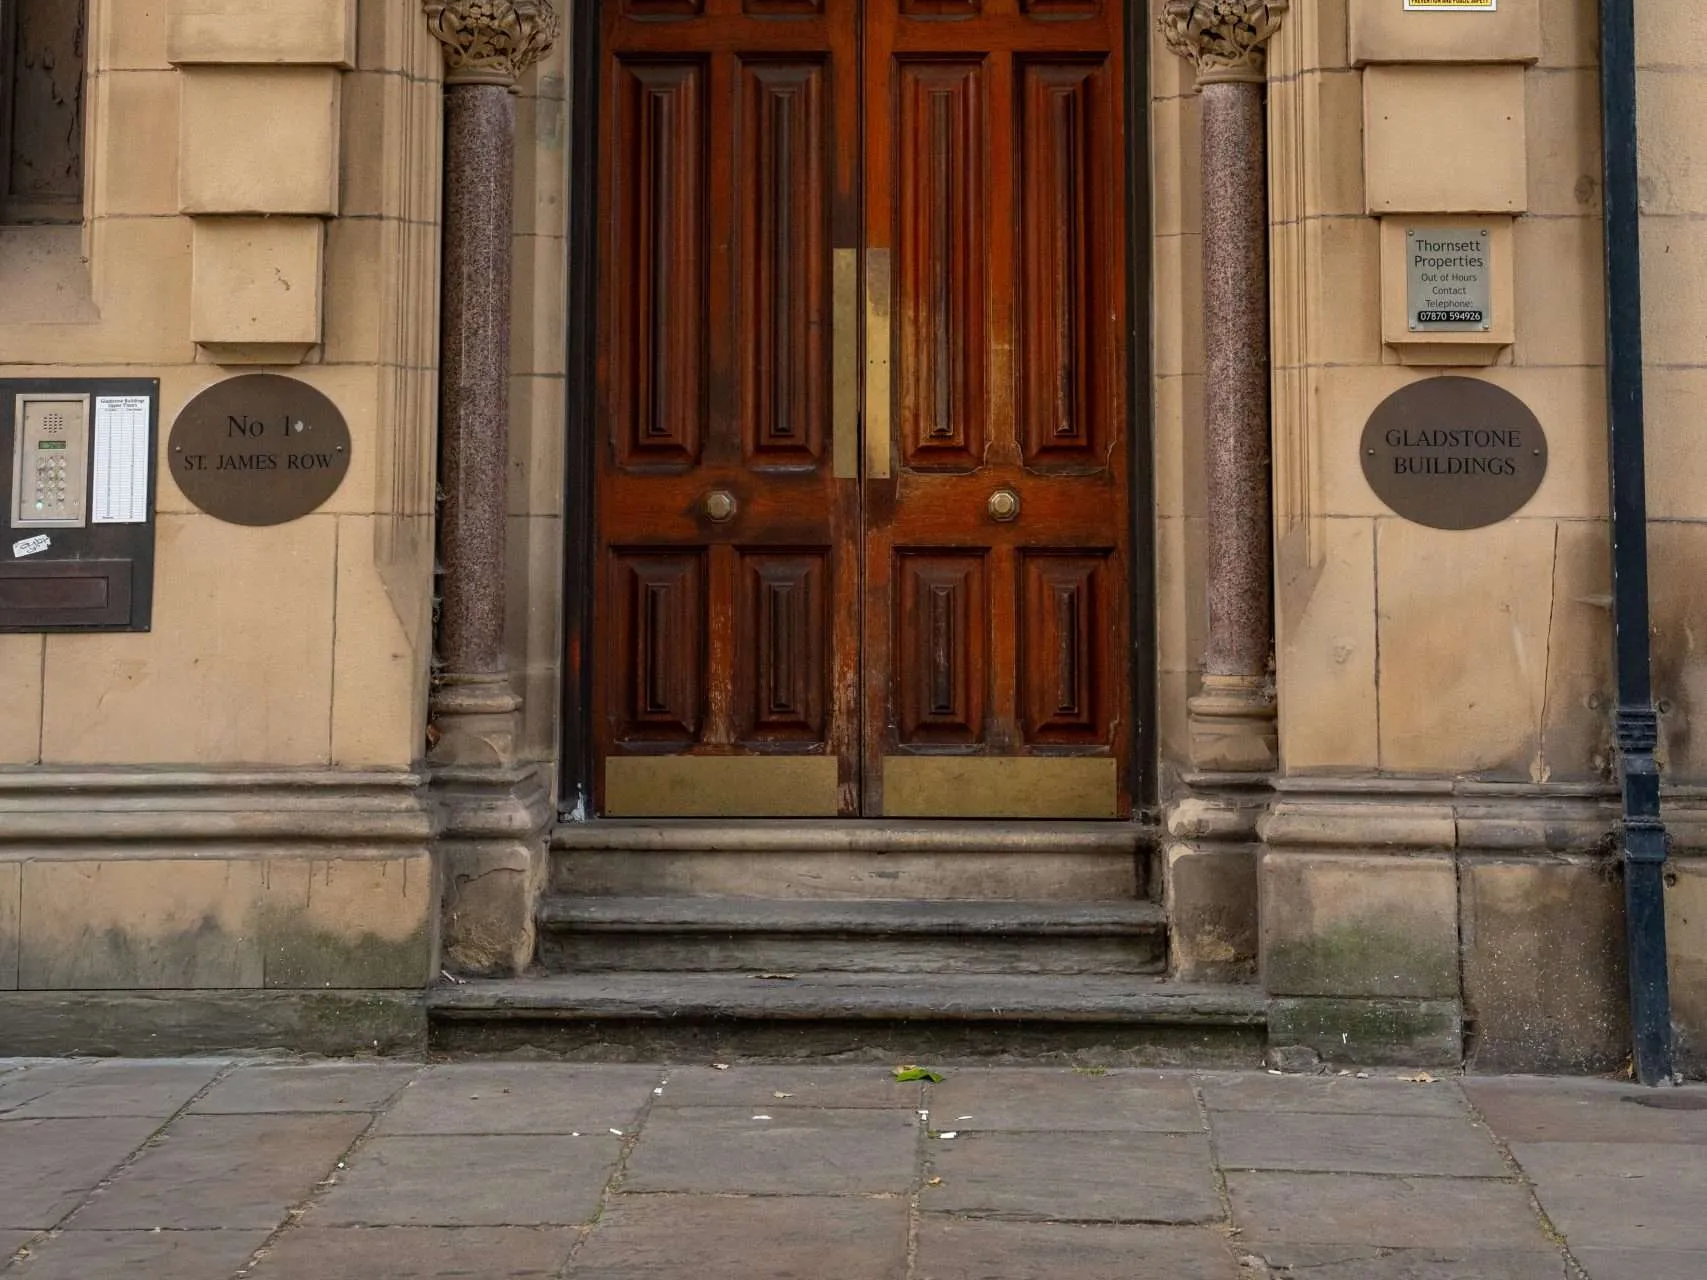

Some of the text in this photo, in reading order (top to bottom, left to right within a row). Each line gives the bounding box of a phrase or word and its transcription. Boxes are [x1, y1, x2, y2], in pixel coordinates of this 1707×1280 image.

[1416, 240, 1480, 252] Thornsett
[1414, 255, 1483, 269] Properties
[1422, 273, 1477, 282] Out of Hours
[1432, 286, 1466, 295] Contact
[1425, 300, 1473, 310] Telephone:
[1420, 312, 1480, 320] 07870 594926
[228, 415, 264, 437] No
[1385, 429, 1521, 448] GLADSTONE
[216, 454, 277, 470] JAMES
[288, 454, 334, 469] ROW
[1394, 457, 1516, 476] BUILDINGS
